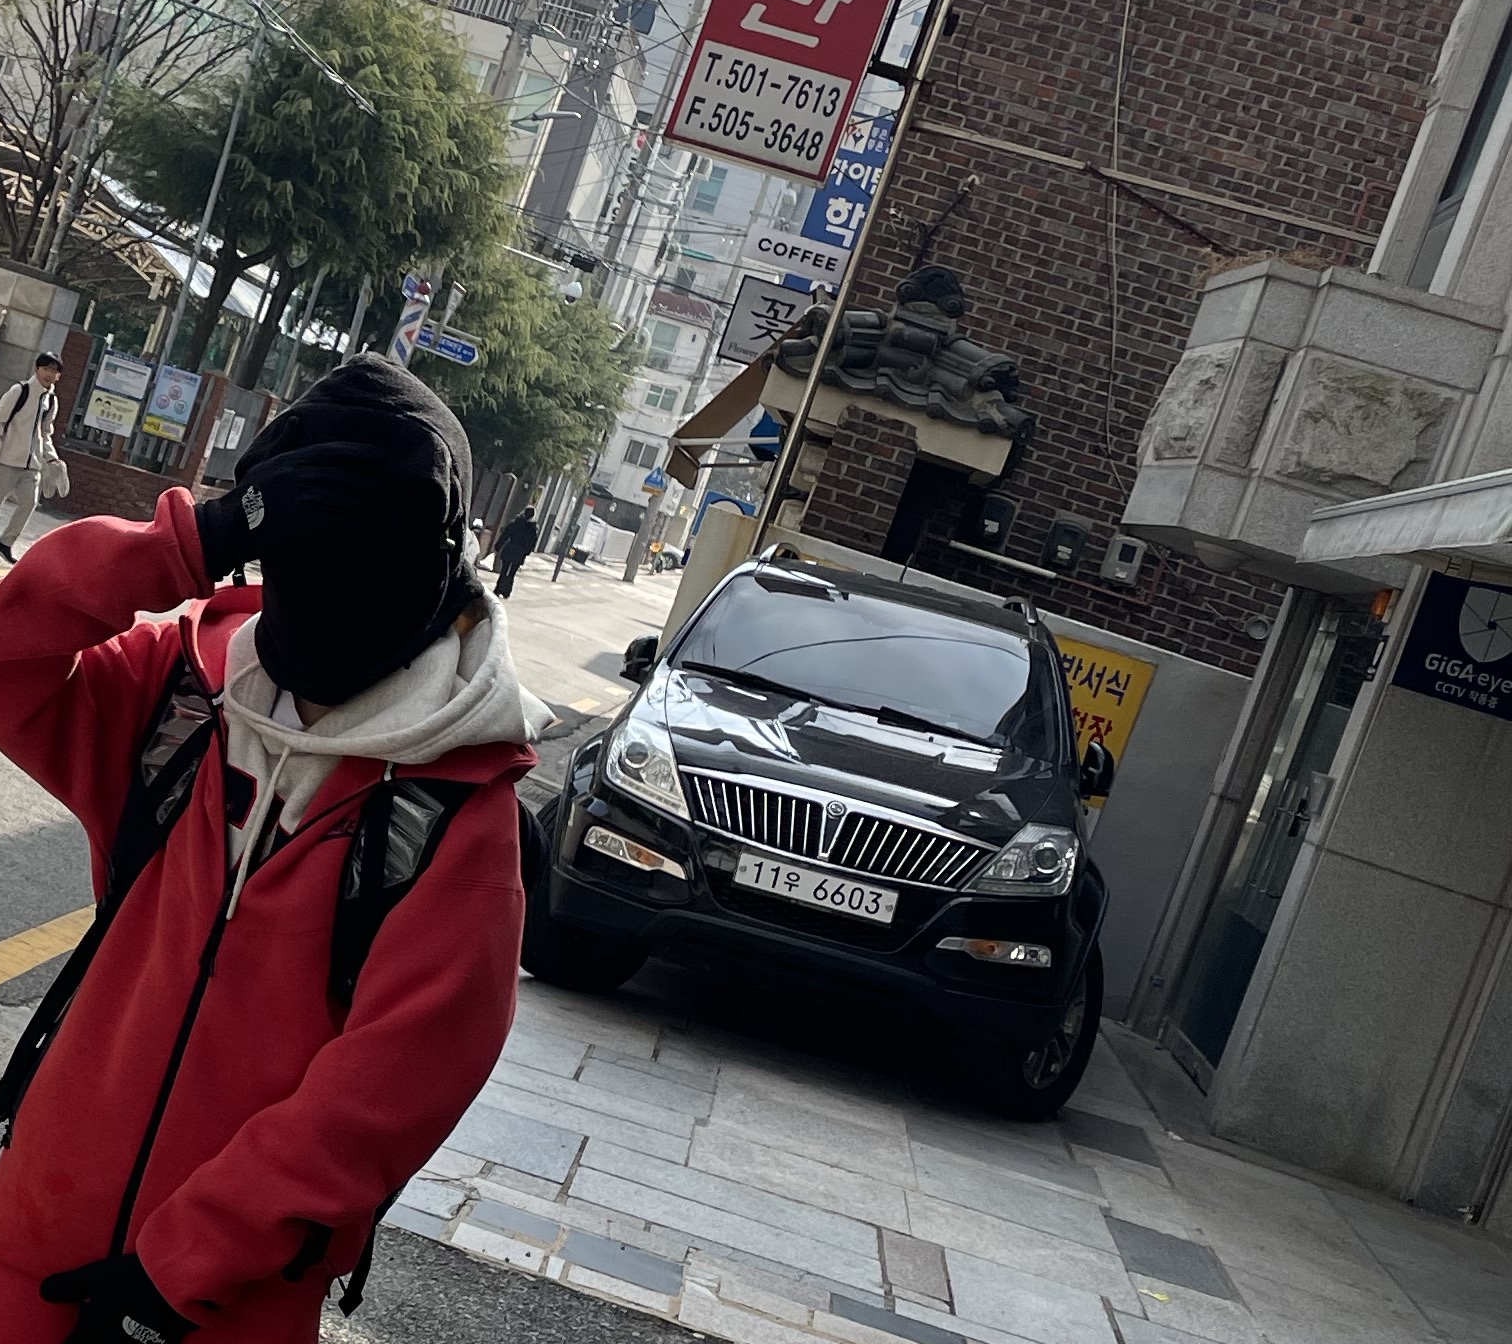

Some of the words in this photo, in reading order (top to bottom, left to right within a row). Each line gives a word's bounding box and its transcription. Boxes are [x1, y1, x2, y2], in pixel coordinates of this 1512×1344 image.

[704, 52, 841, 119] T.501-7613
[684, 95, 825, 162] F.505-3648
[758, 237, 839, 272] COFFEE
[749, 295, 798, 343] 꽃
[1435, 680, 1467, 698] CCTV
[753, 860, 801, 893] 11우
[813, 878, 883, 915] 6603
